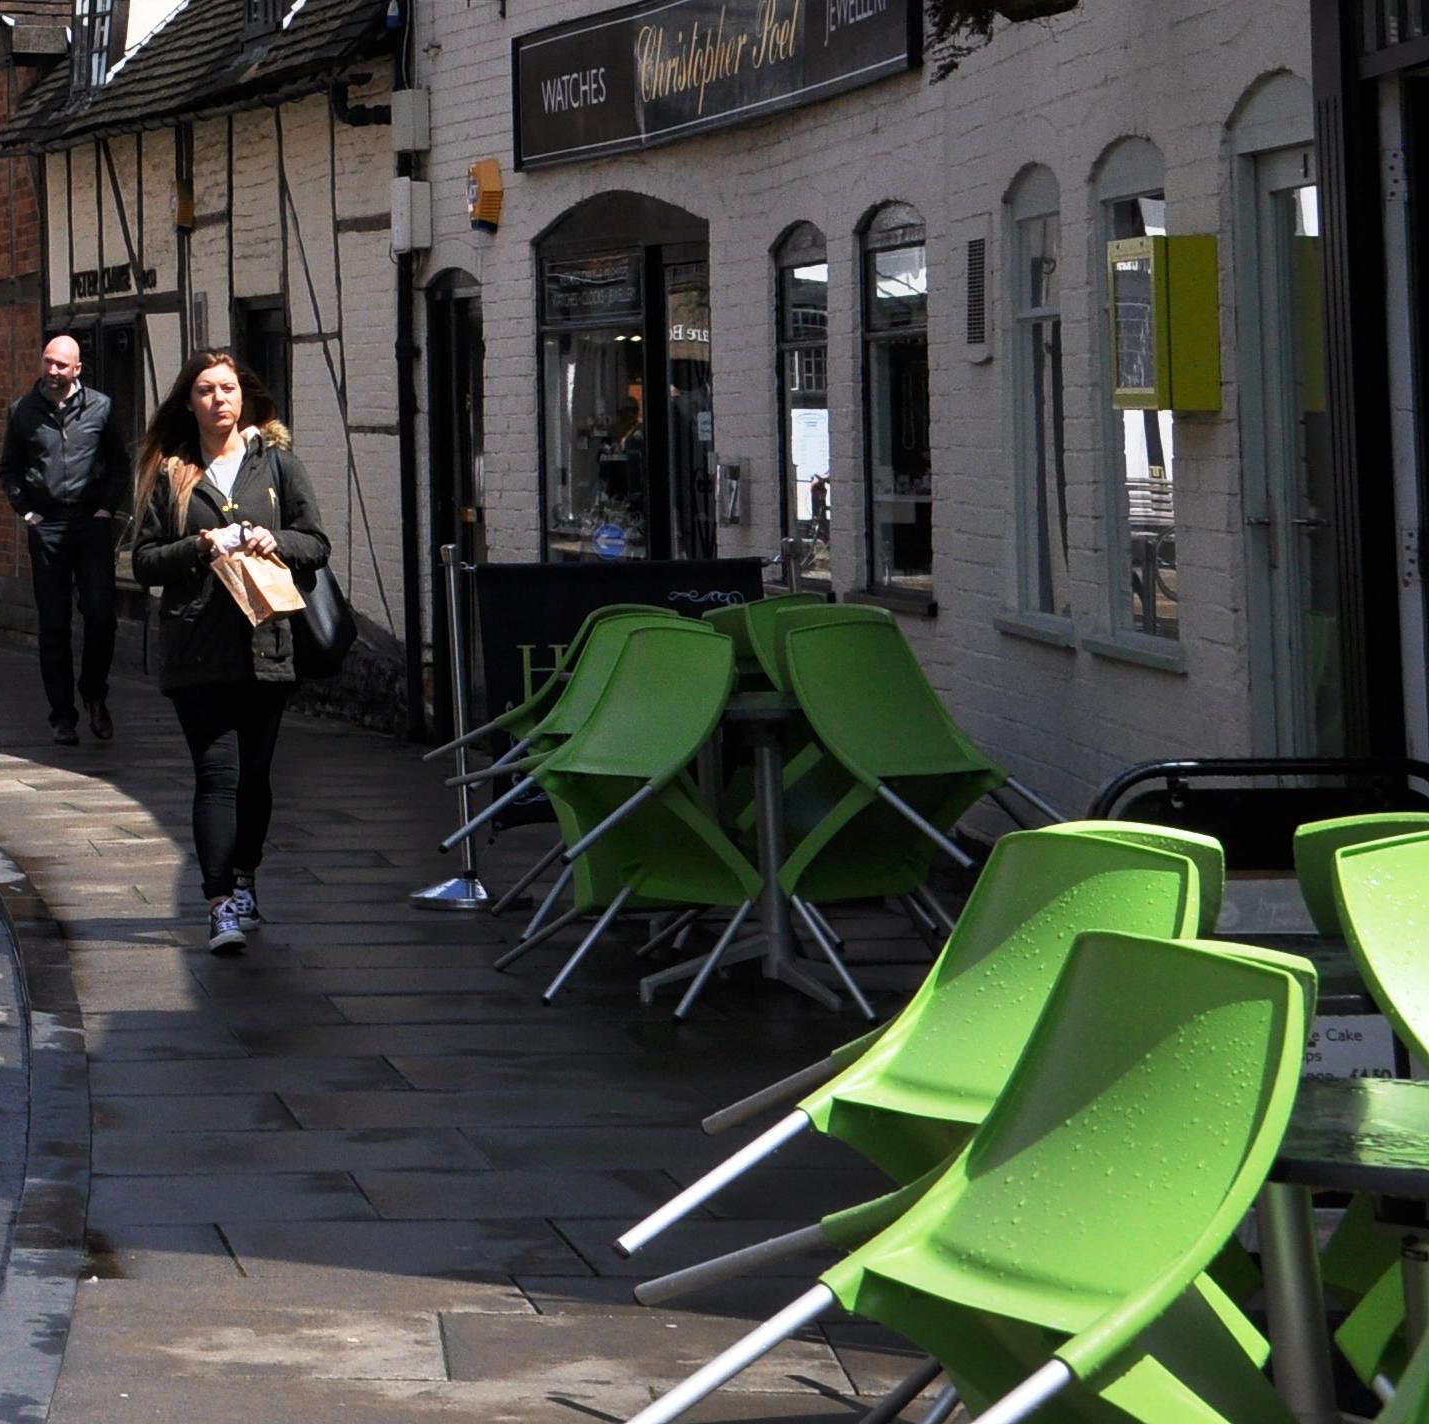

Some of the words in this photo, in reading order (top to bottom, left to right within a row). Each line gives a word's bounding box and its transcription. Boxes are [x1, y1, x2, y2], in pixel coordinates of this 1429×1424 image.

[542, 68, 606, 114] WATCHES
[638, 5, 748, 115] Christopher
[1325, 1027, 1363, 1042] Cake
